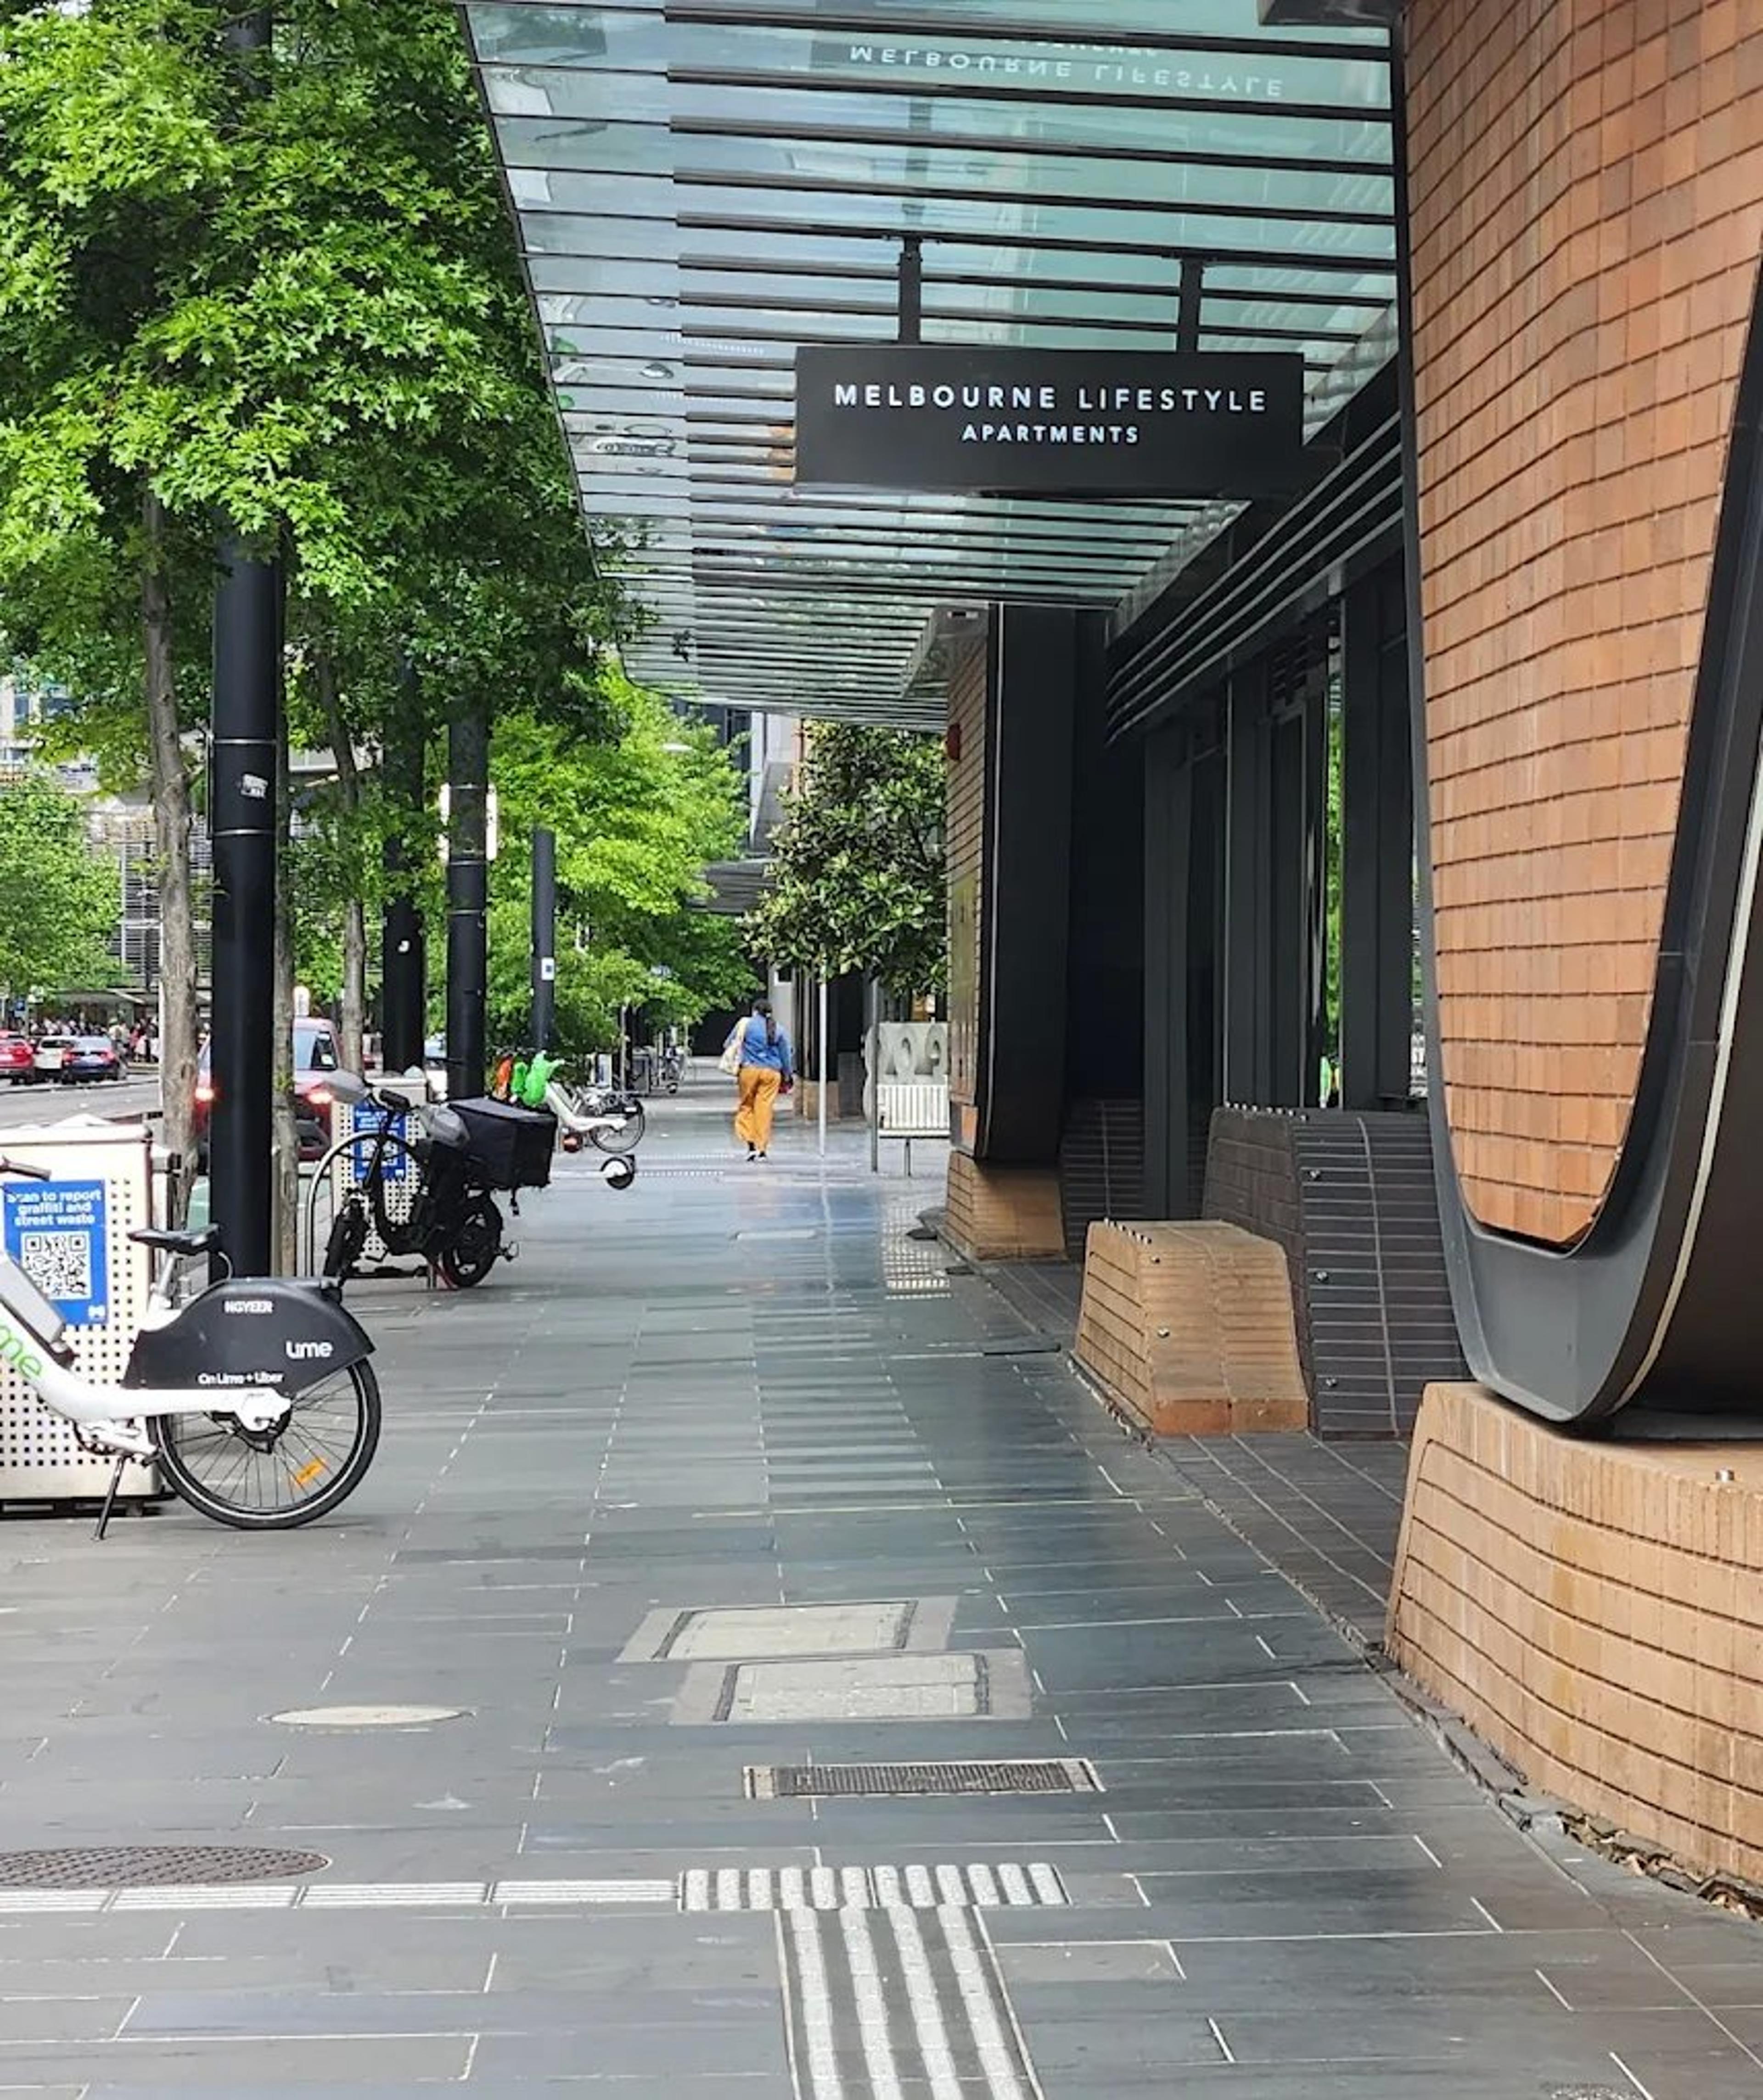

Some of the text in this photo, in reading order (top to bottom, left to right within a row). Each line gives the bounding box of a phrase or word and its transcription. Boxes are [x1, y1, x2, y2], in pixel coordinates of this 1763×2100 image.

[835, 384, 1266, 411] MELBOURNE LIFESTYLE
[961, 424, 1139, 443] APARTMENTS
[42, 1191, 56, 1201] to
[59, 1189, 101, 1203] report
[66, 1201, 91, 1212] and
[15, 1214, 95, 1226] street waste
